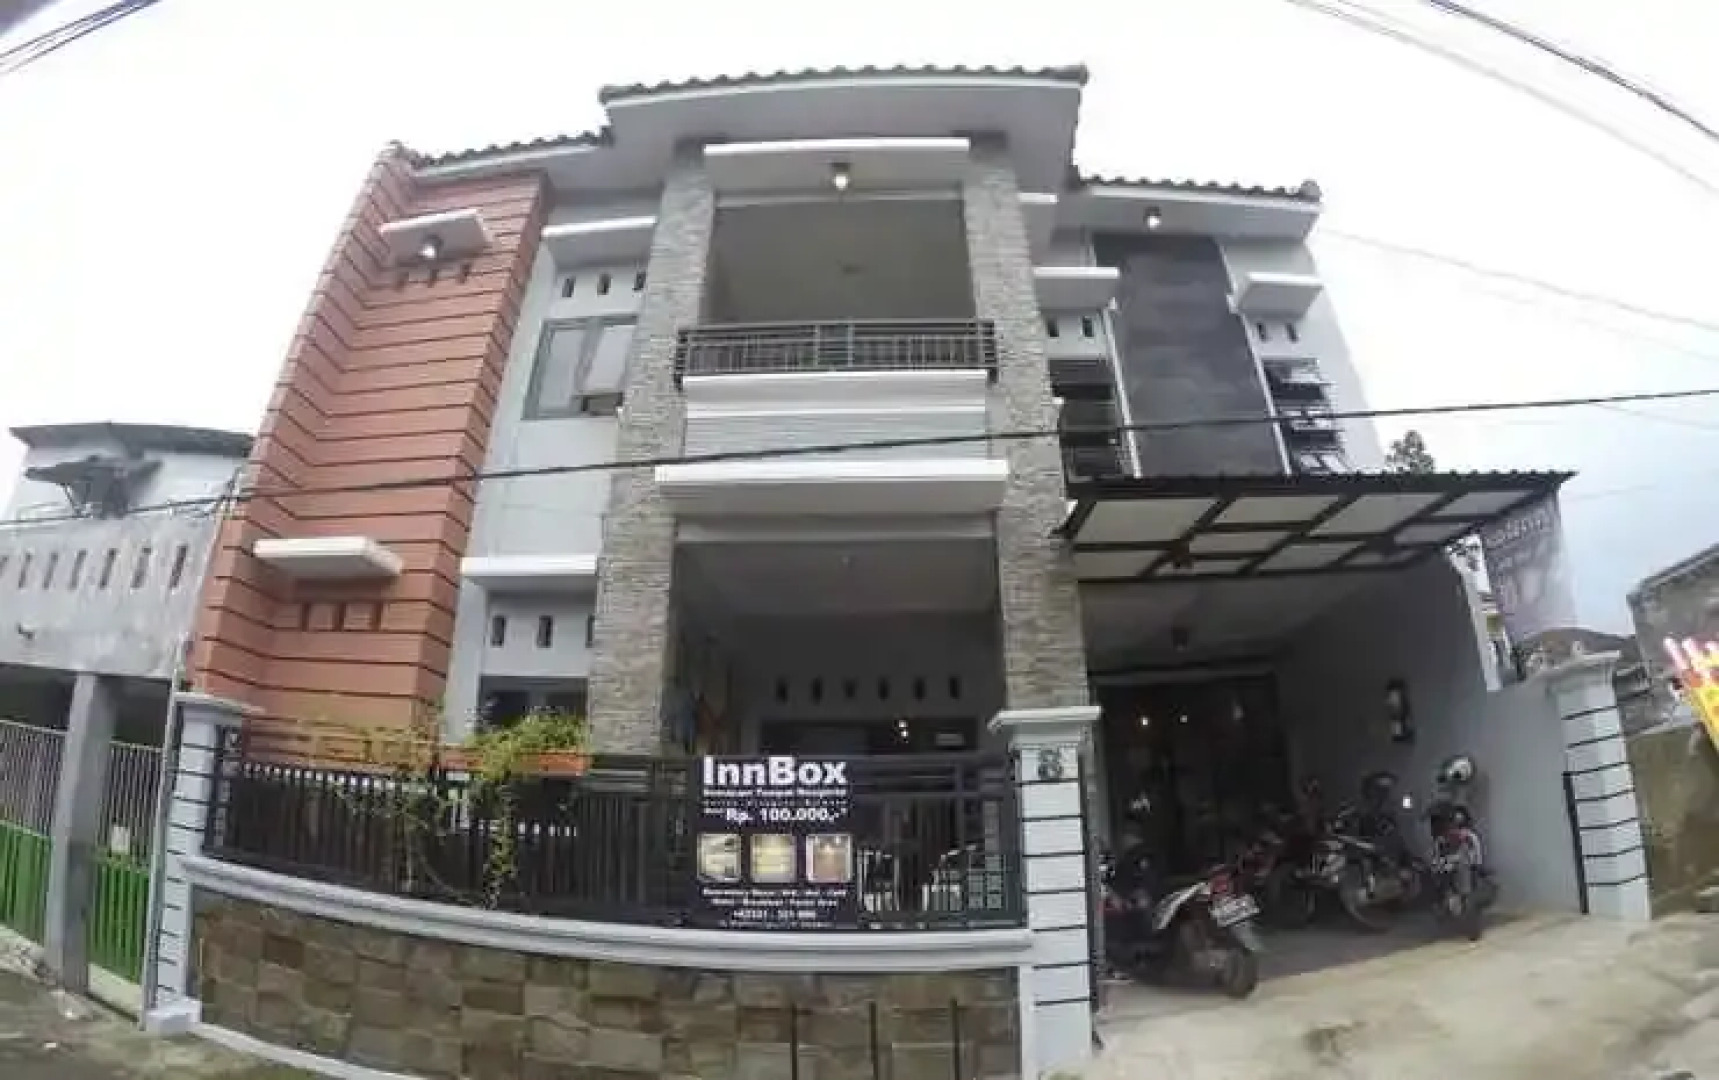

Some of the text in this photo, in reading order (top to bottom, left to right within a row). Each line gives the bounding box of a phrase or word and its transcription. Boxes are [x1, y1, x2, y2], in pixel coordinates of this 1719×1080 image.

[703, 756, 847, 785] InnBox
[1038, 749, 1064, 780] 8
[726, 808, 753, 825] Rp.
